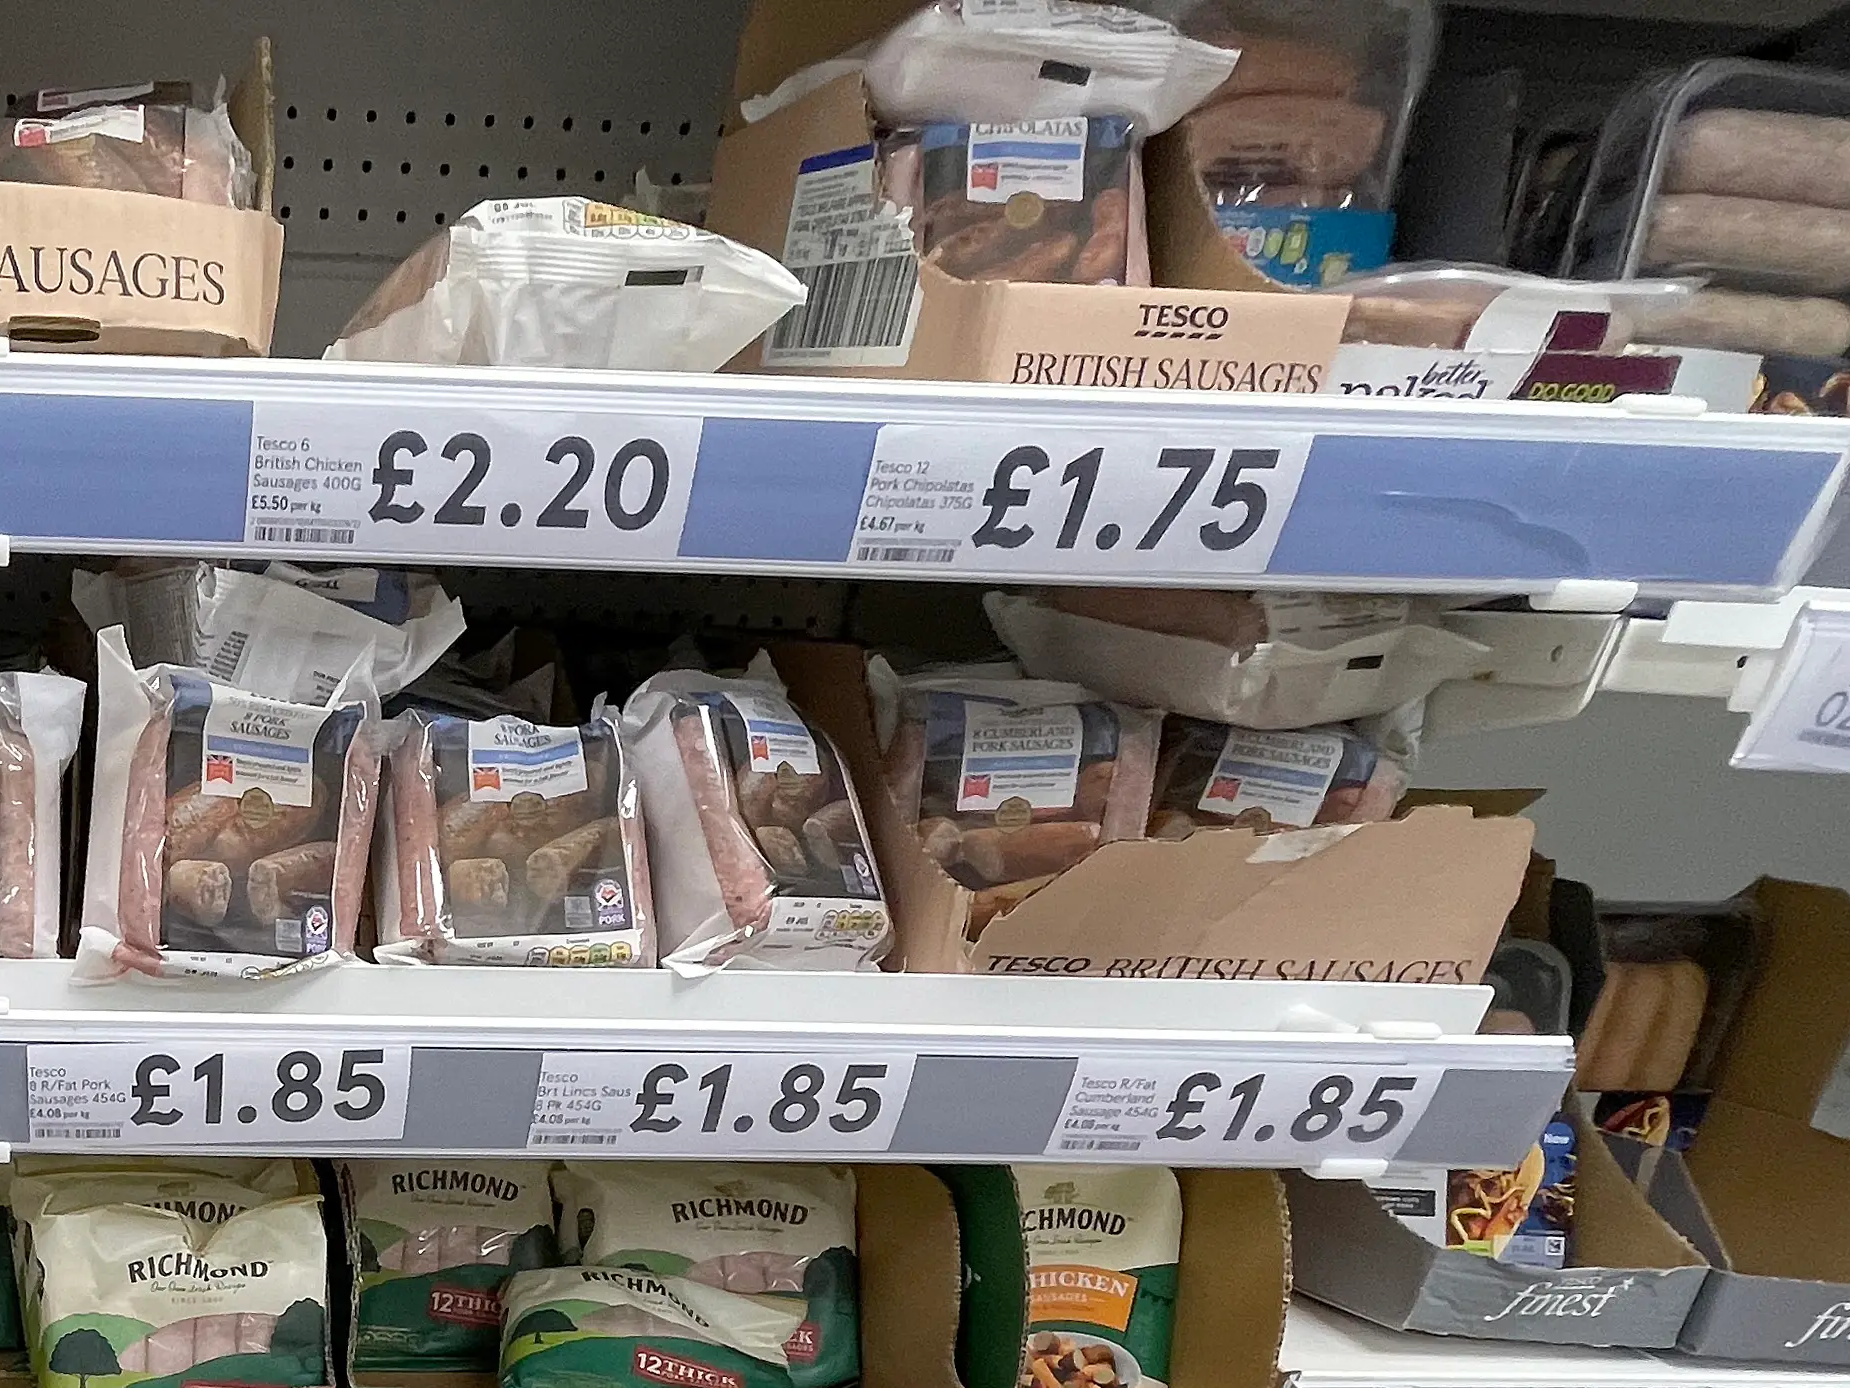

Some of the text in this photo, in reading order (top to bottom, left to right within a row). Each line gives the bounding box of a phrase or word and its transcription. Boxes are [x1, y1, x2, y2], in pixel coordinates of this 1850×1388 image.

[1139, 305, 1228, 328] TESCO
[1010, 353, 1322, 393] BRITISH SAUSAGES
[1421, 362, 1483, 388] better
[1530, 383, 1616, 401] DO GOOD
[256, 436, 310, 452] Tesco 6
[254, 456, 362, 472] British Chicken
[875, 460, 929, 474] Tesco 12
[253, 475, 361, 491] Sausages 400G
[368, 430, 669, 531] £2.20
[870, 478, 974, 494] Pork Chipolatas
[866, 495, 973, 510] Chipolatas 375G
[972, 445, 1281, 551] £1.75
[860, 515, 895, 533] £4.67
[30, 1066, 66, 1077] Tesco
[542, 1071, 578, 1082] Tesco
[29, 1092, 126, 1105] Sausages 454G
[130, 1049, 387, 1127] £1.85
[629, 1064, 887, 1133] £1.85
[1075, 1092, 1154, 1104] Cumberland
[1070, 1106, 1158, 1118] Sausage 454G
[1156, 1072, 1417, 1143] £1.85
[392, 1170, 518, 1201] RICHMOND
[672, 1199, 808, 1225] RICHMOND
[128, 1253, 269, 1284] RICHMOND
[581, 1270, 709, 1328] RICHMOND
[1485, 1280, 1618, 1321] finest
[638, 1353, 736, 1388] 12 THICK
